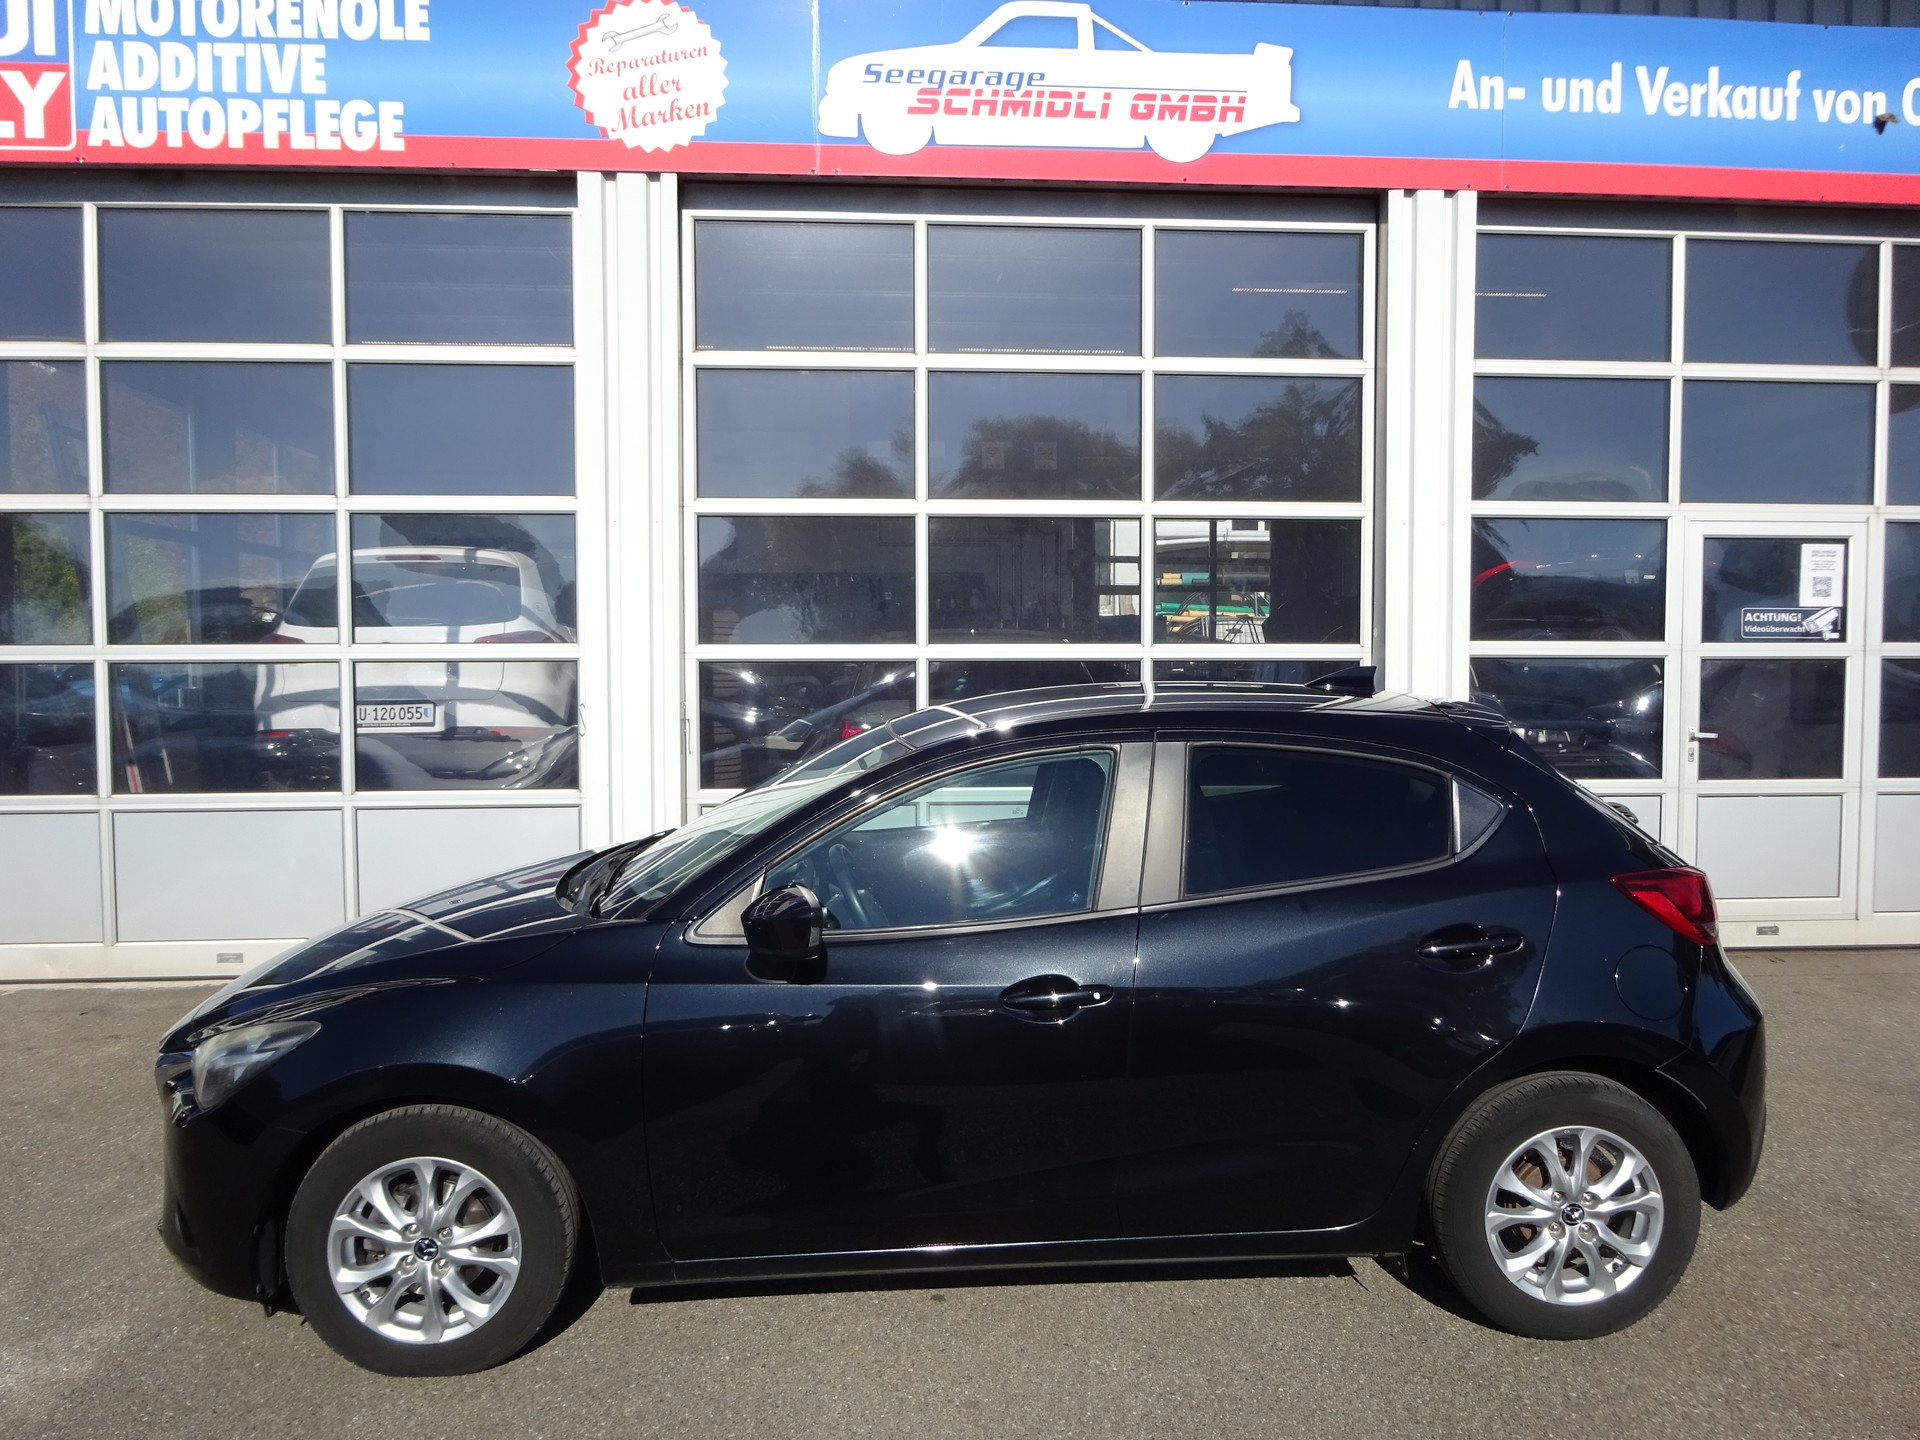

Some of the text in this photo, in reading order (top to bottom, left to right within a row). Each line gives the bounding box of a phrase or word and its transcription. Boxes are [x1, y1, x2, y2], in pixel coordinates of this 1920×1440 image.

[86, 40, 327, 94] ADDITIVE
[588, 45, 708, 77] Reparaturen
[862, 63, 1046, 92] Seegarage
[622, 72, 683, 101] aller
[1448, 58, 1526, 111] An-
[1541, 61, 1622, 114] und
[1635, 65, 1801, 122] Verkauf
[1812, 87, 1886, 125] von
[610, 98, 712, 133] Marken
[907, 88, 1247, 123] SCHMIDLI GMBH
[87, 96, 405, 152] AUTOPFLEGE
[1744, 612, 1802, 622] ACHTUNG!
[1744, 625, 1806, 633] Videoüberwacht
